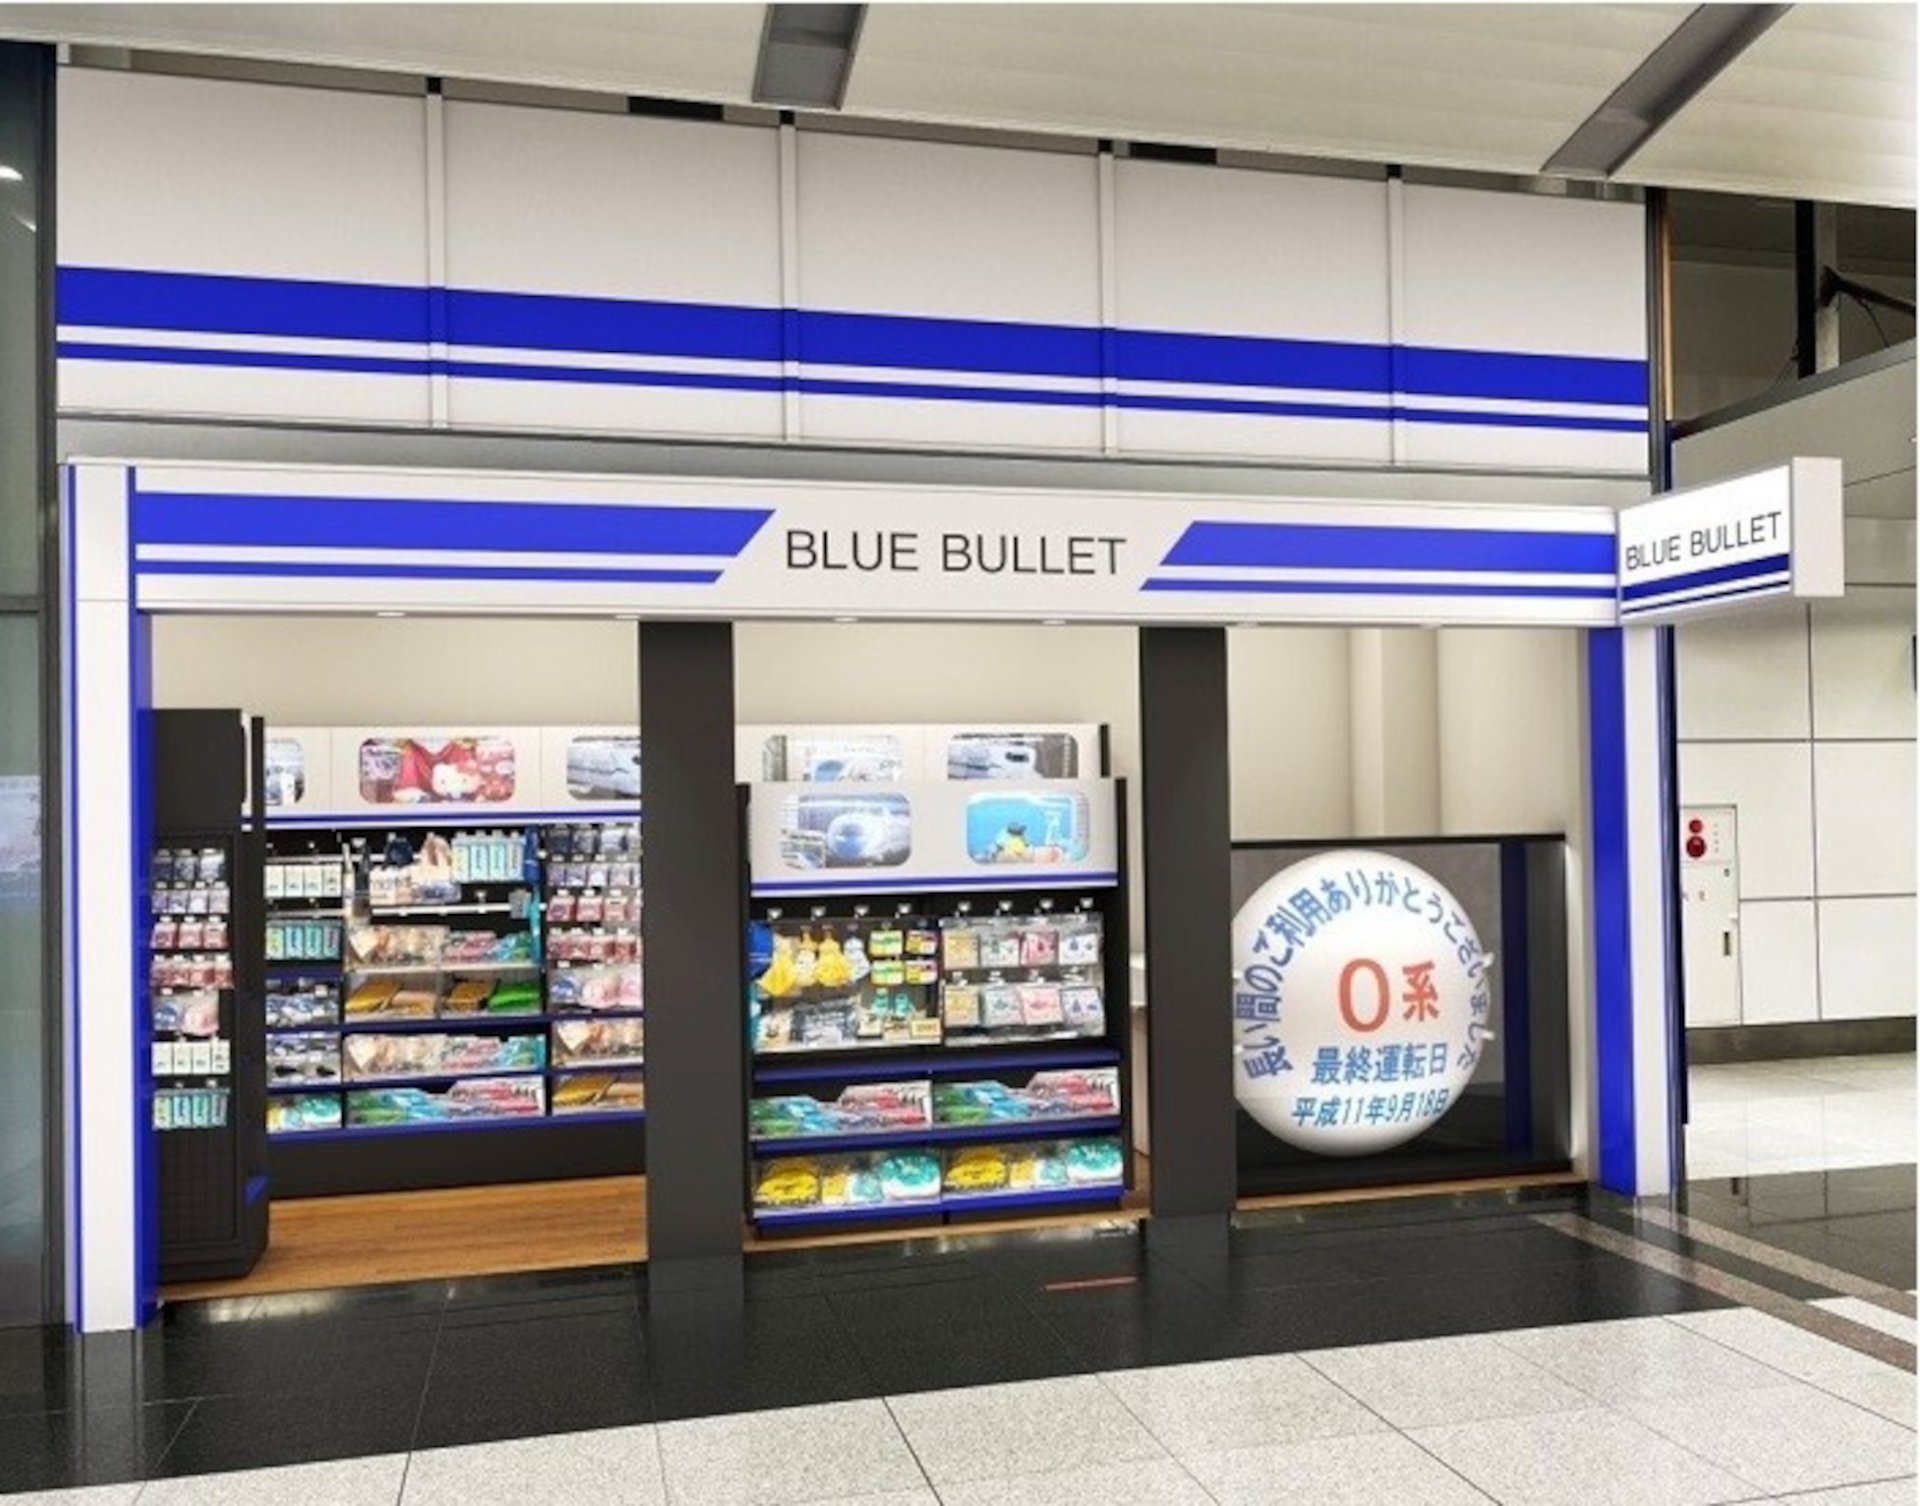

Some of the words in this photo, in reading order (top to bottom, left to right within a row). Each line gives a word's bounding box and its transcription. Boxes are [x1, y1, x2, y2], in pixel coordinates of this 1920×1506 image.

[786, 530, 919, 571] BLUE
[942, 534, 1127, 574] BULLET
[1626, 535, 1681, 570] BLUE
[1691, 511, 1781, 556] BULLET
[1310, 1043, 1448, 1084] 最終運転日
[1291, 1088, 1449, 1127] 平成11年9月18日
